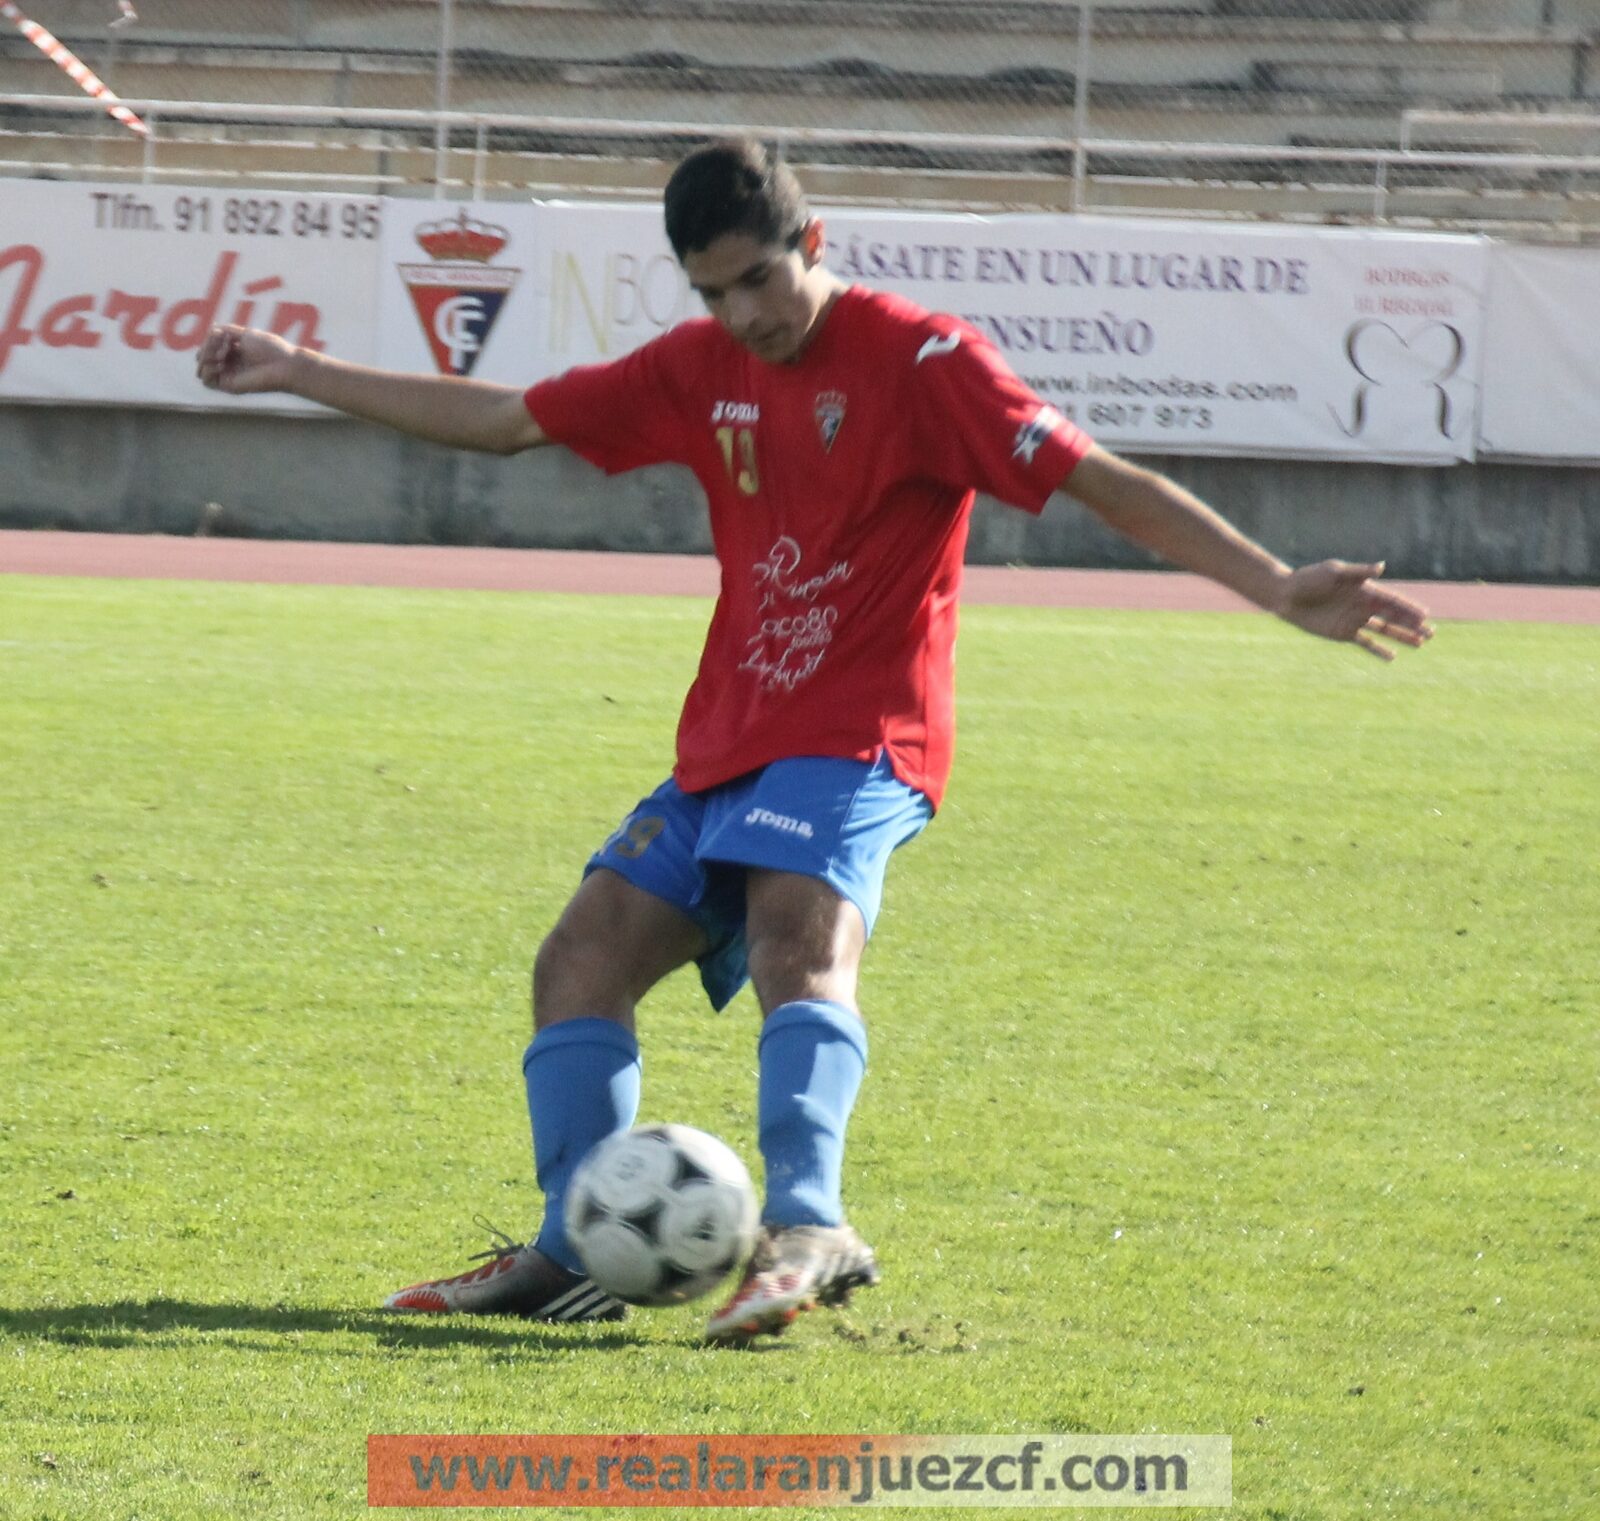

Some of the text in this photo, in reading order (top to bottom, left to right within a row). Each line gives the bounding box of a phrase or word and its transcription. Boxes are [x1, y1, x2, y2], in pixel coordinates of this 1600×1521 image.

[89, 192, 382, 240] Tlfn. 91 892 84 95
[975, 245, 1028, 284] EN
[1039, 247, 1098, 288] UN
[1106, 250, 1247, 293] LUGAR
[1253, 255, 1310, 295] DE
[0, 244, 326, 376] Jardín
[1154, 403, 1214, 430] 973
[744, 807, 814, 841] Joma
